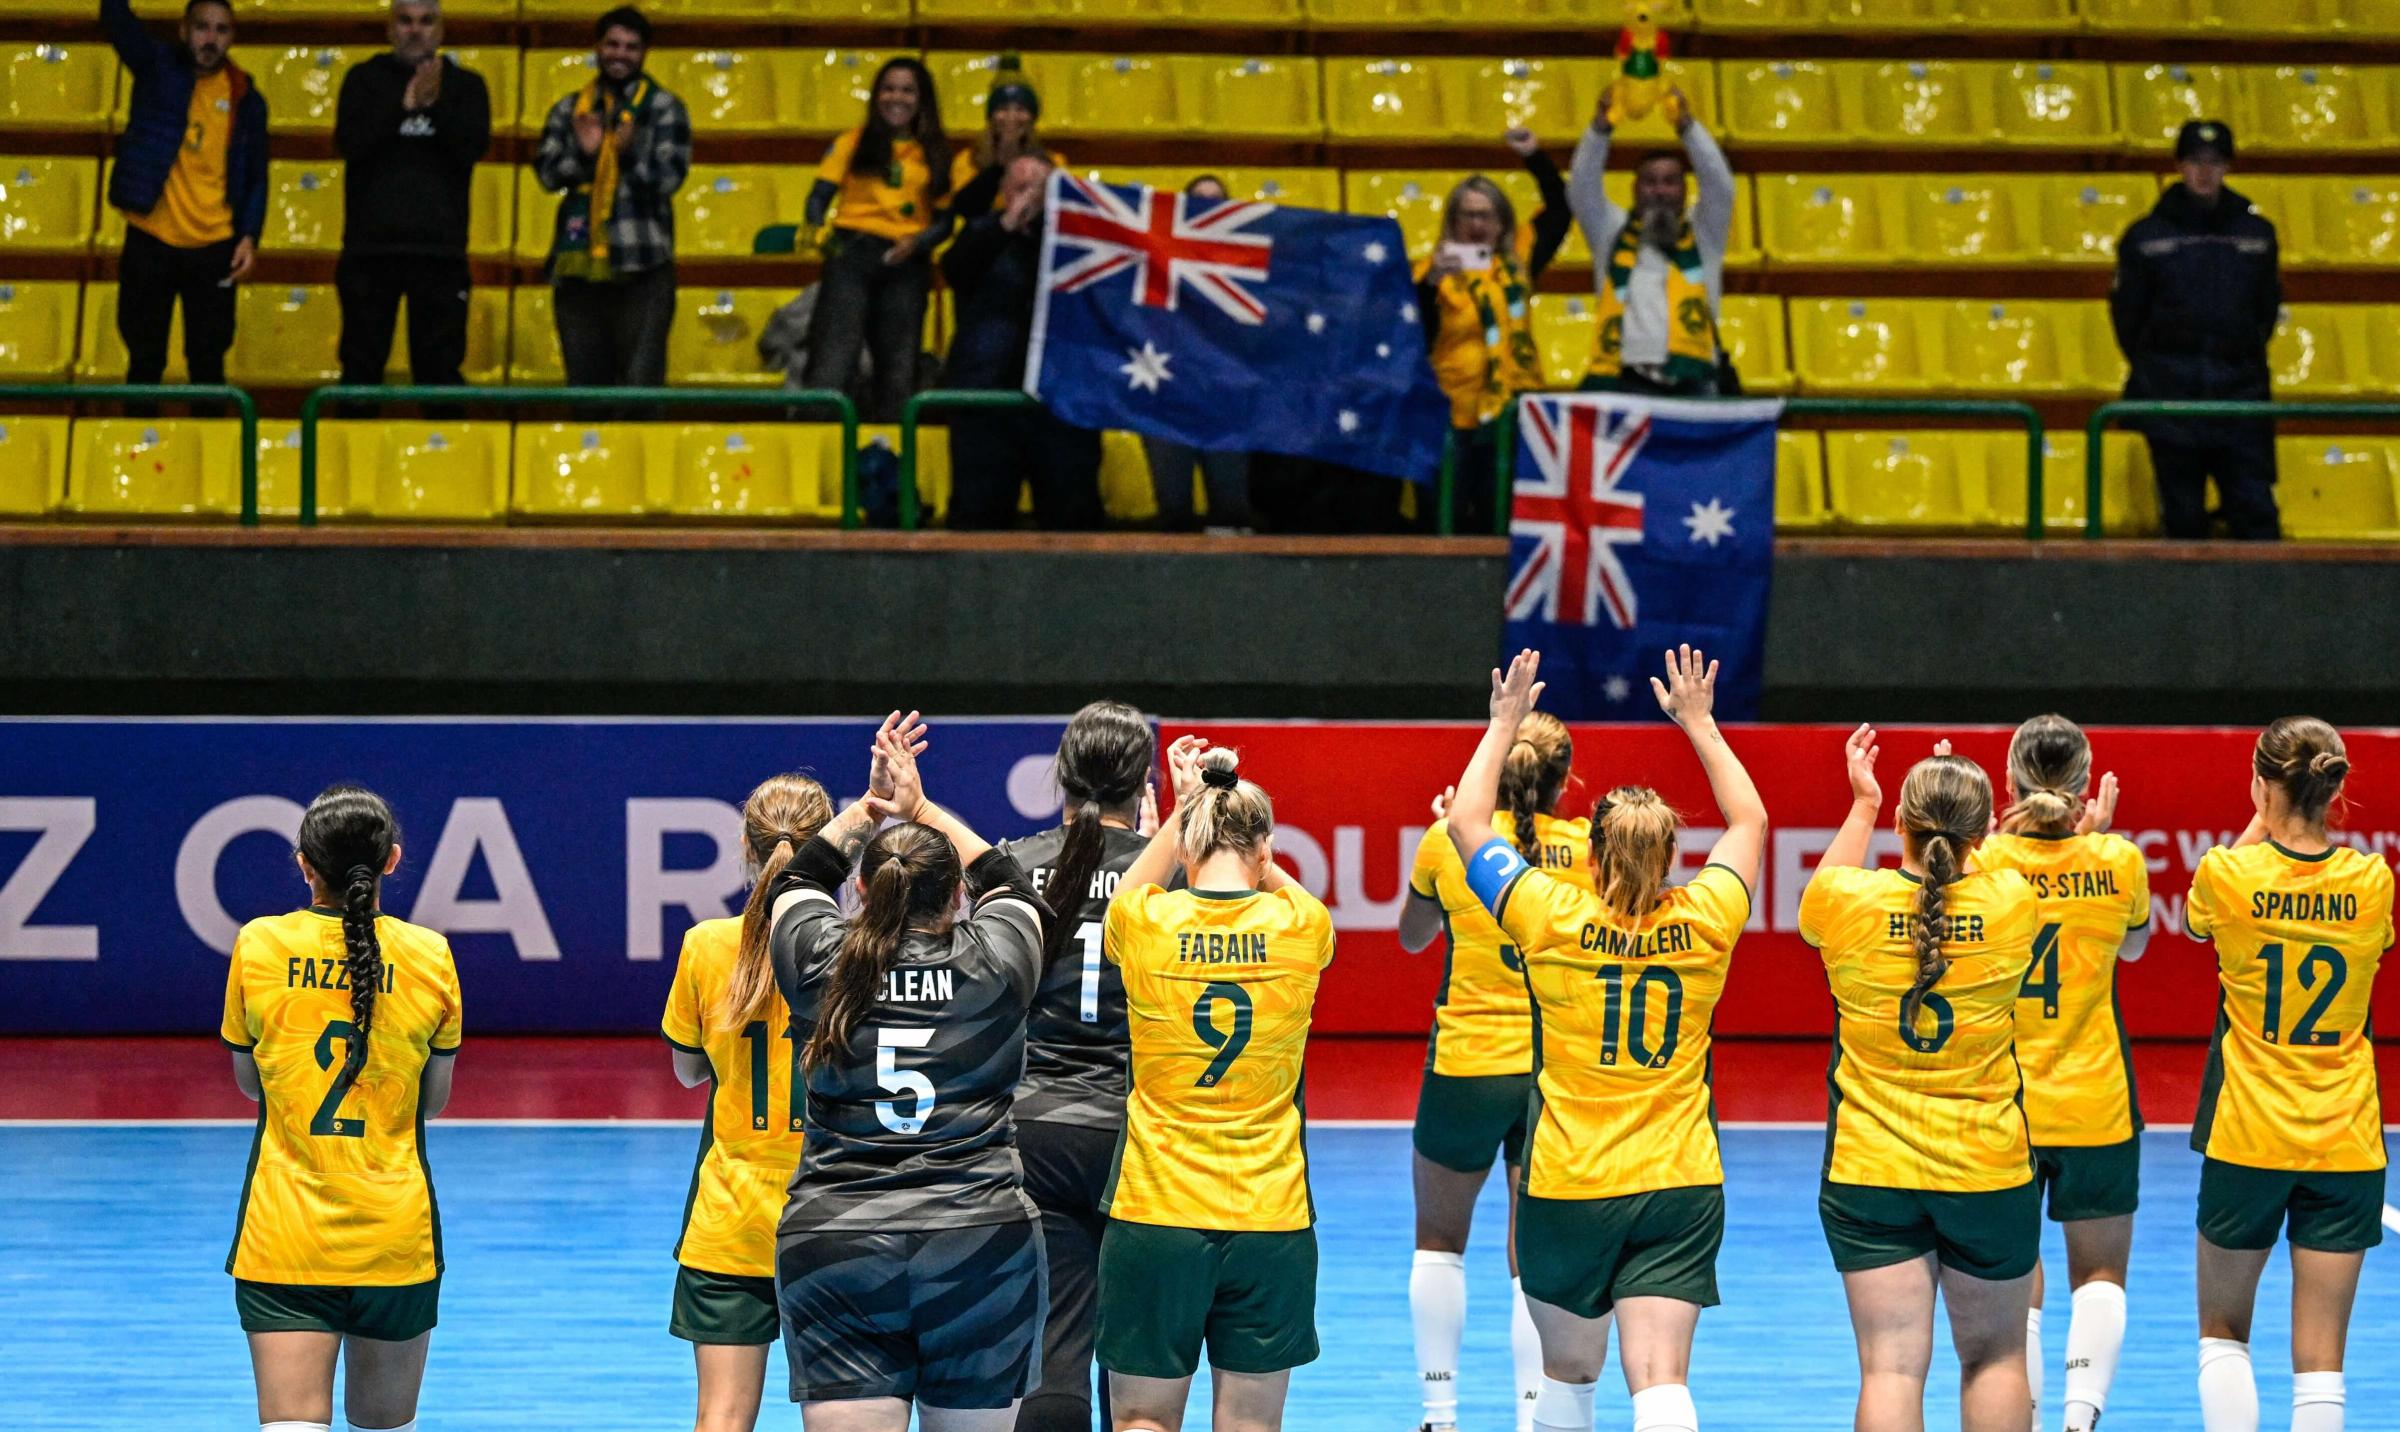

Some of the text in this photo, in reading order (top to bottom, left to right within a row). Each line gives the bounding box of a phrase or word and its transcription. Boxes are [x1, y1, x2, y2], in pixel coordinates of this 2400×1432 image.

[0, 795, 976, 960] ZCAR
[2021, 870, 2120, 899] YS-STAHL
[2251, 891, 2357, 921] SPADANO
[288, 957, 394, 994] FAZZRI
[1073, 921, 1102, 1023] 1
[1178, 932, 1267, 963] TABAIN
[1580, 922, 1692, 959] CAMILLERI
[2018, 922, 2062, 1019] 4
[1192, 981, 1253, 1088] 9
[1594, 964, 1684, 1069] 10
[1899, 960, 1954, 1053] 6
[2256, 943, 2347, 1046] 12
[310, 1020, 368, 1138] 2
[874, 1028, 937, 1134] 5
[1425, 1372, 1452, 1382] AUS
